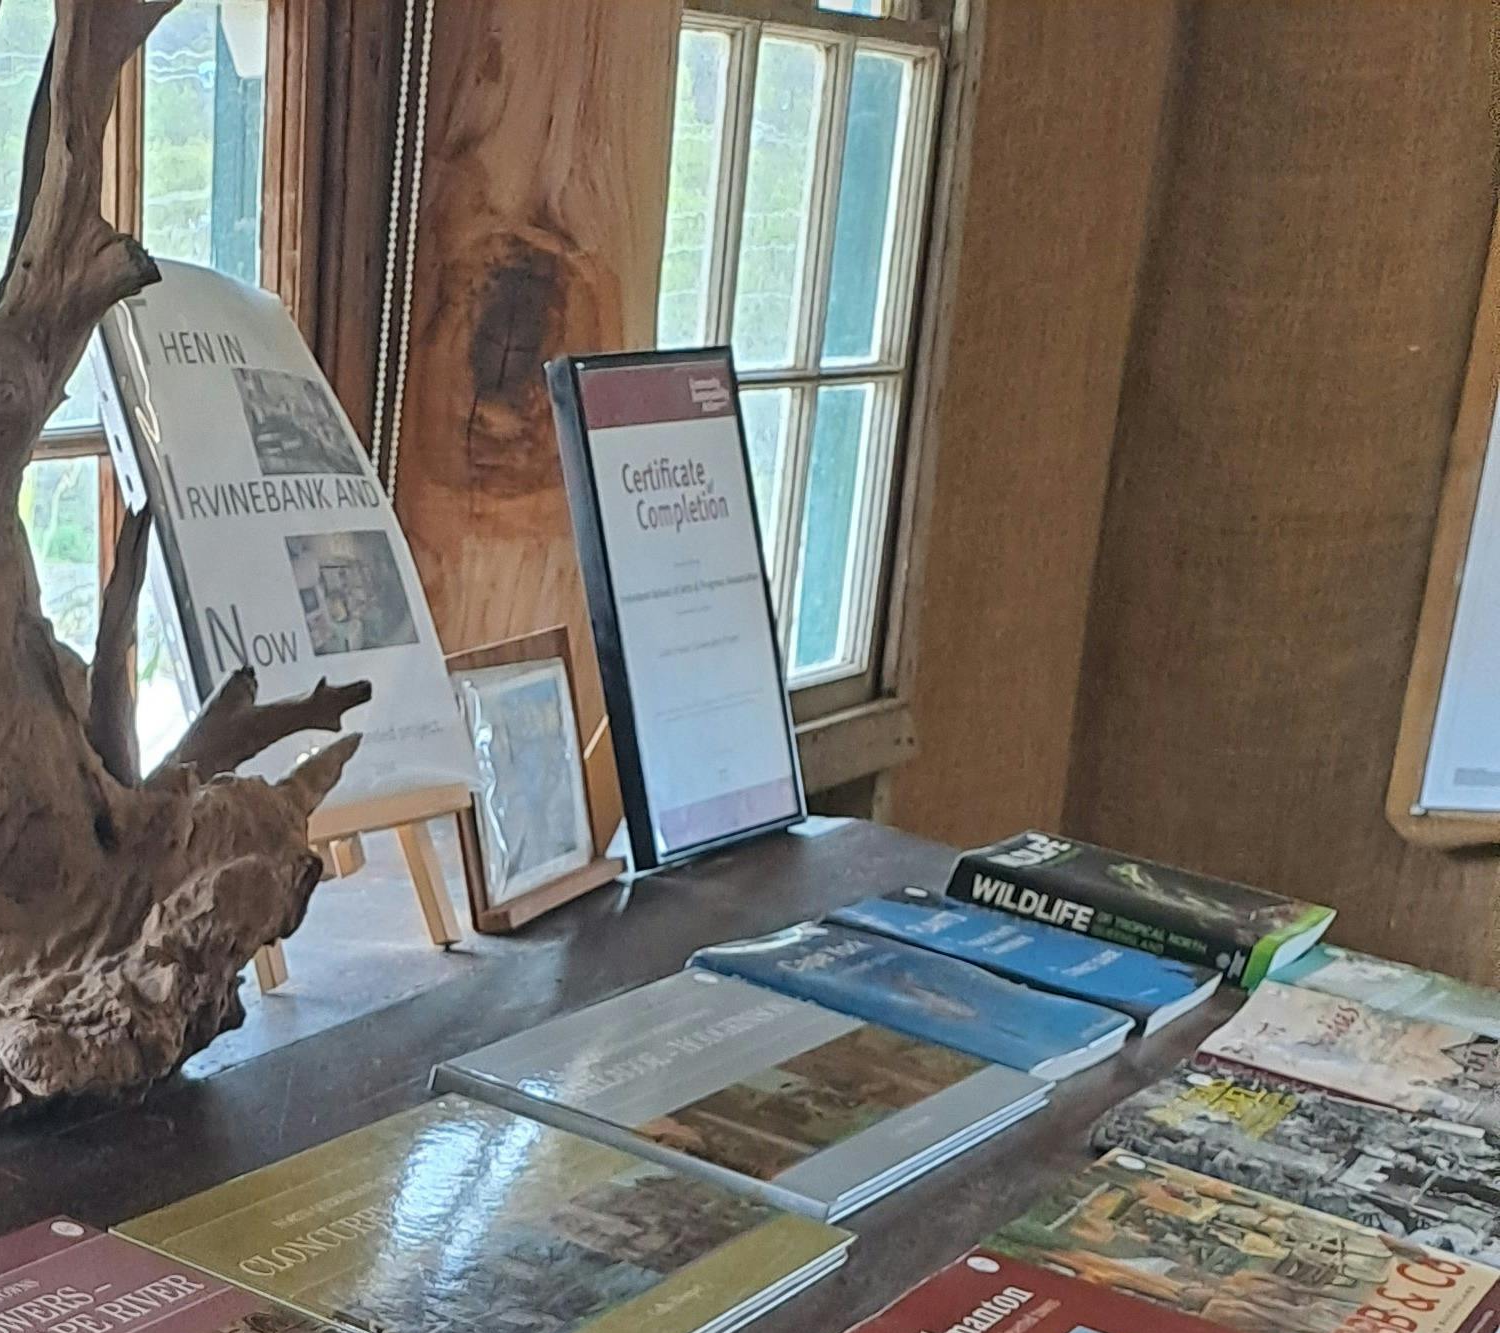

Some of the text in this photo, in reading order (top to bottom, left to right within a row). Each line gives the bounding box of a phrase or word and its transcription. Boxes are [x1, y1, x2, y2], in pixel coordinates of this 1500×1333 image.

[216, 332, 247, 365] IN
[165, 454, 382, 521] IRVINEBANK AND
[622, 457, 706, 494] Certificate
[636, 494, 730, 533] Completion
[972, 872, 1096, 933] WILDLIFE
[101, 1273, 206, 1324] RIVER
